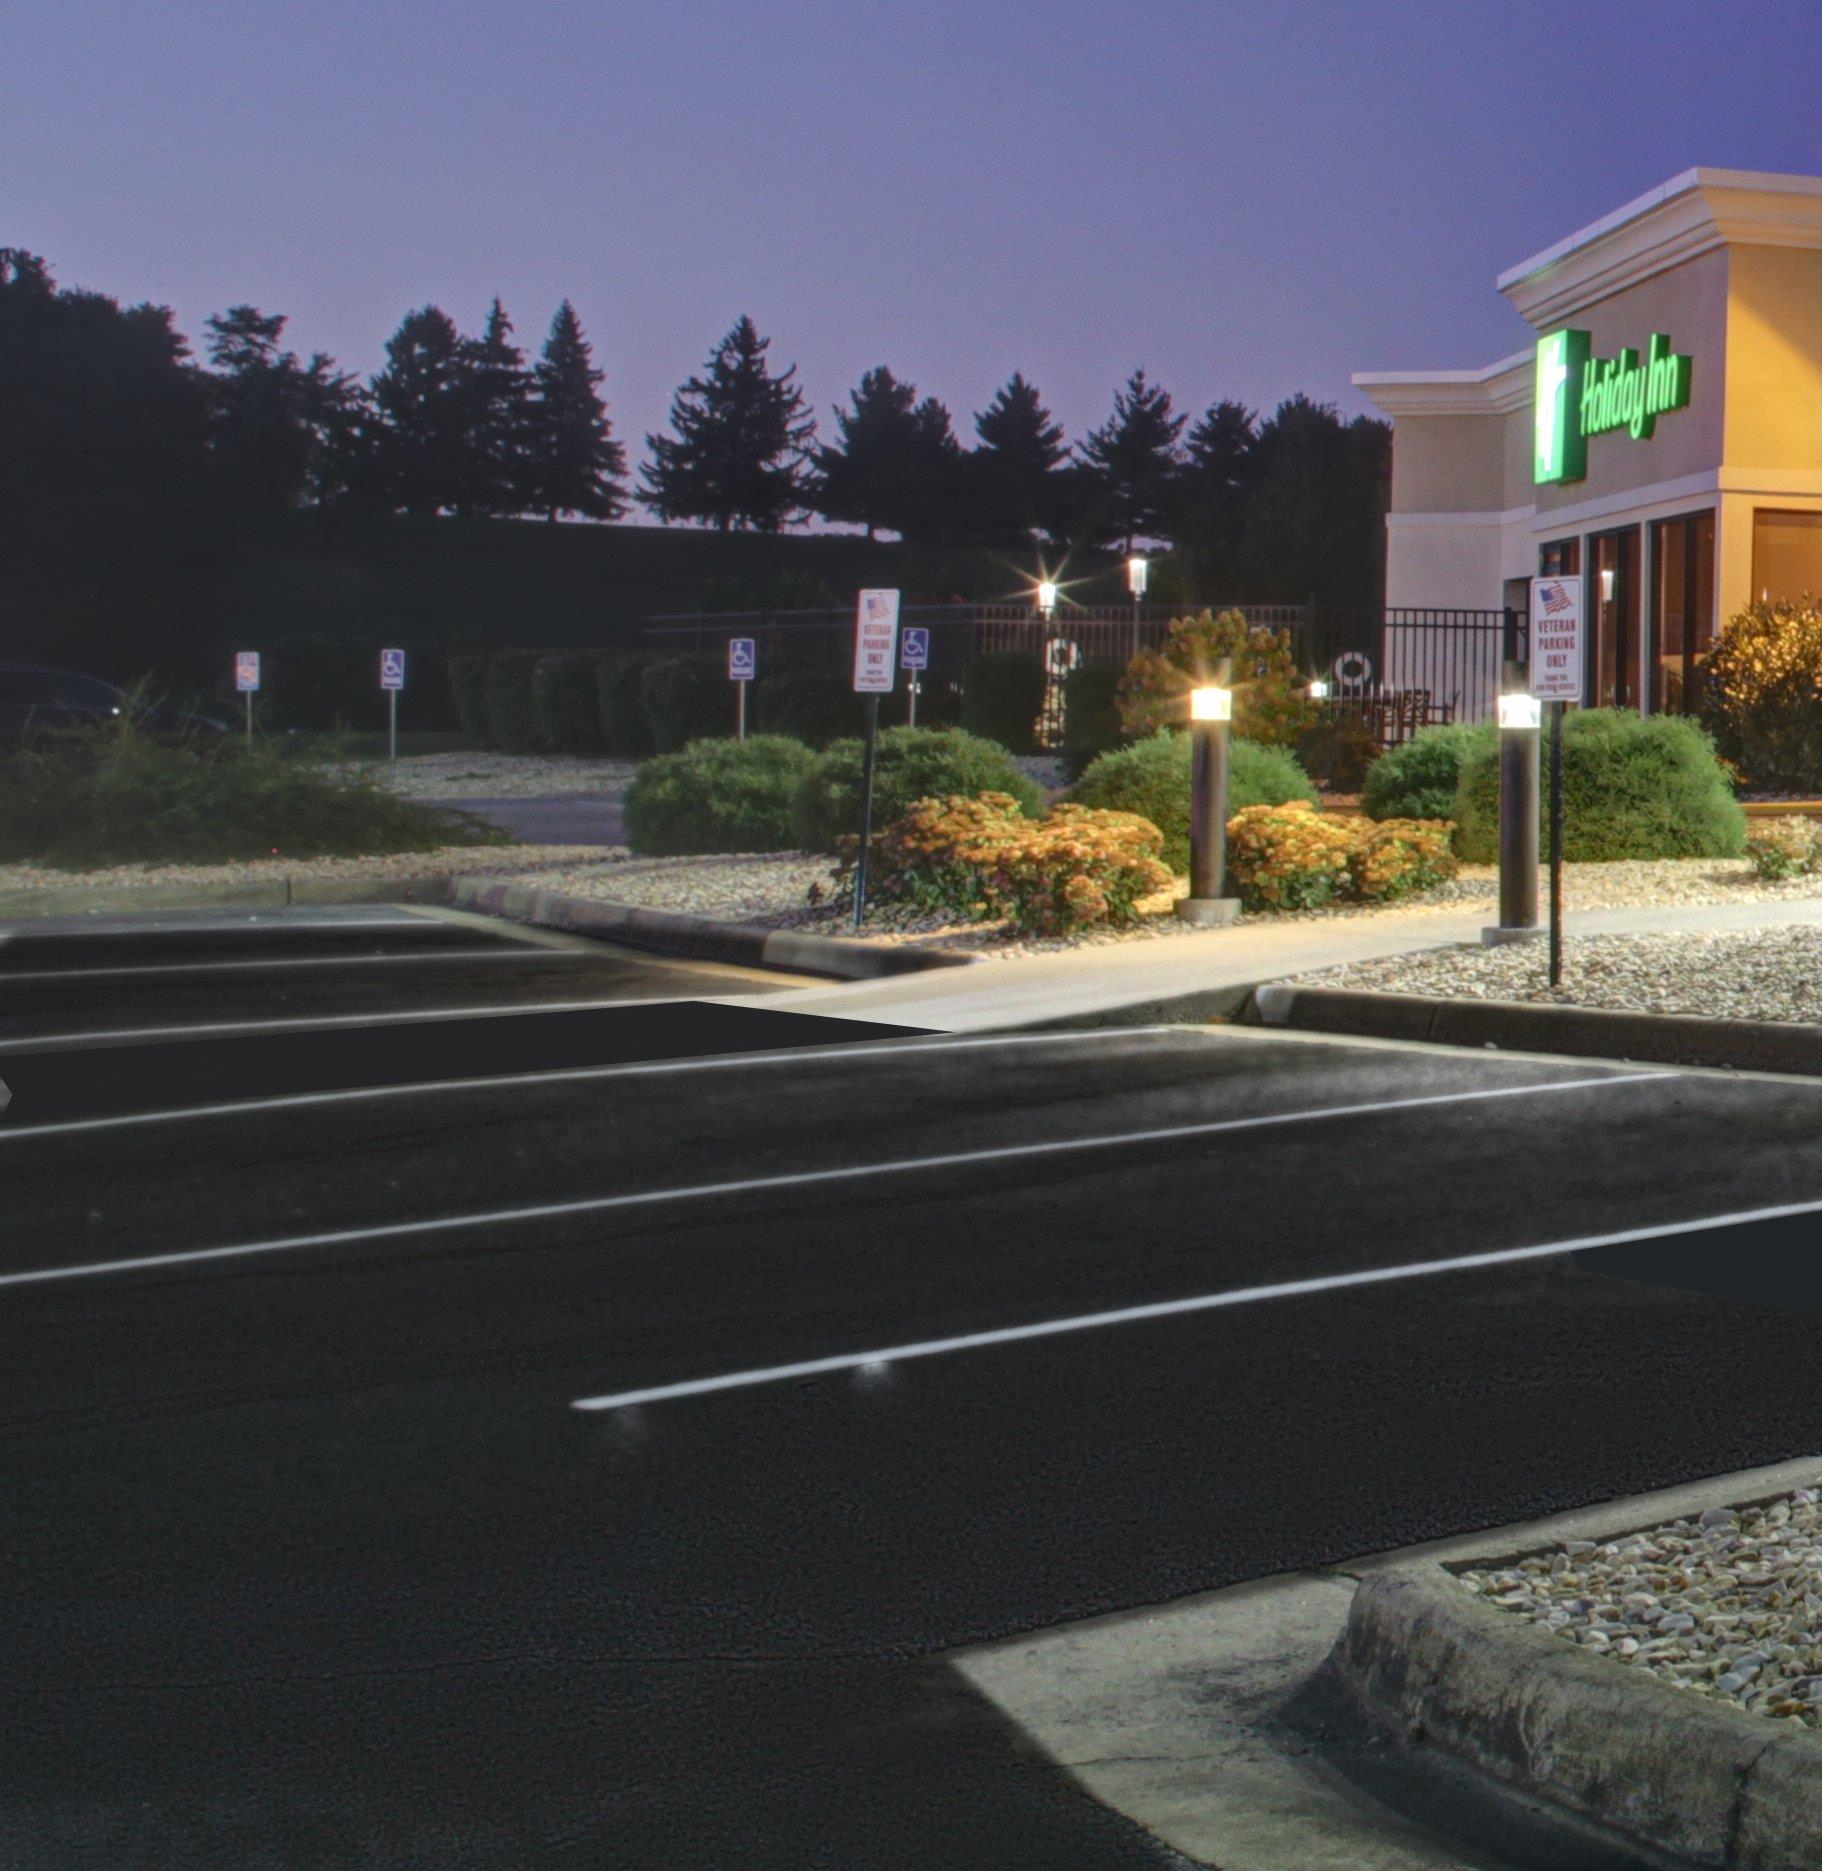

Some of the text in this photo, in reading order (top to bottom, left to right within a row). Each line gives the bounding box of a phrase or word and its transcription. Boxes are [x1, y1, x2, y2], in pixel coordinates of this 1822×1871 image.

[1579, 332, 1680, 440] Holiday Inn
[1538, 618, 1576, 633] VETERAN
[863, 638, 890, 650] PARKING
[1538, 636, 1575, 651] PARKING
[1546, 653, 1567, 669] ONLY
